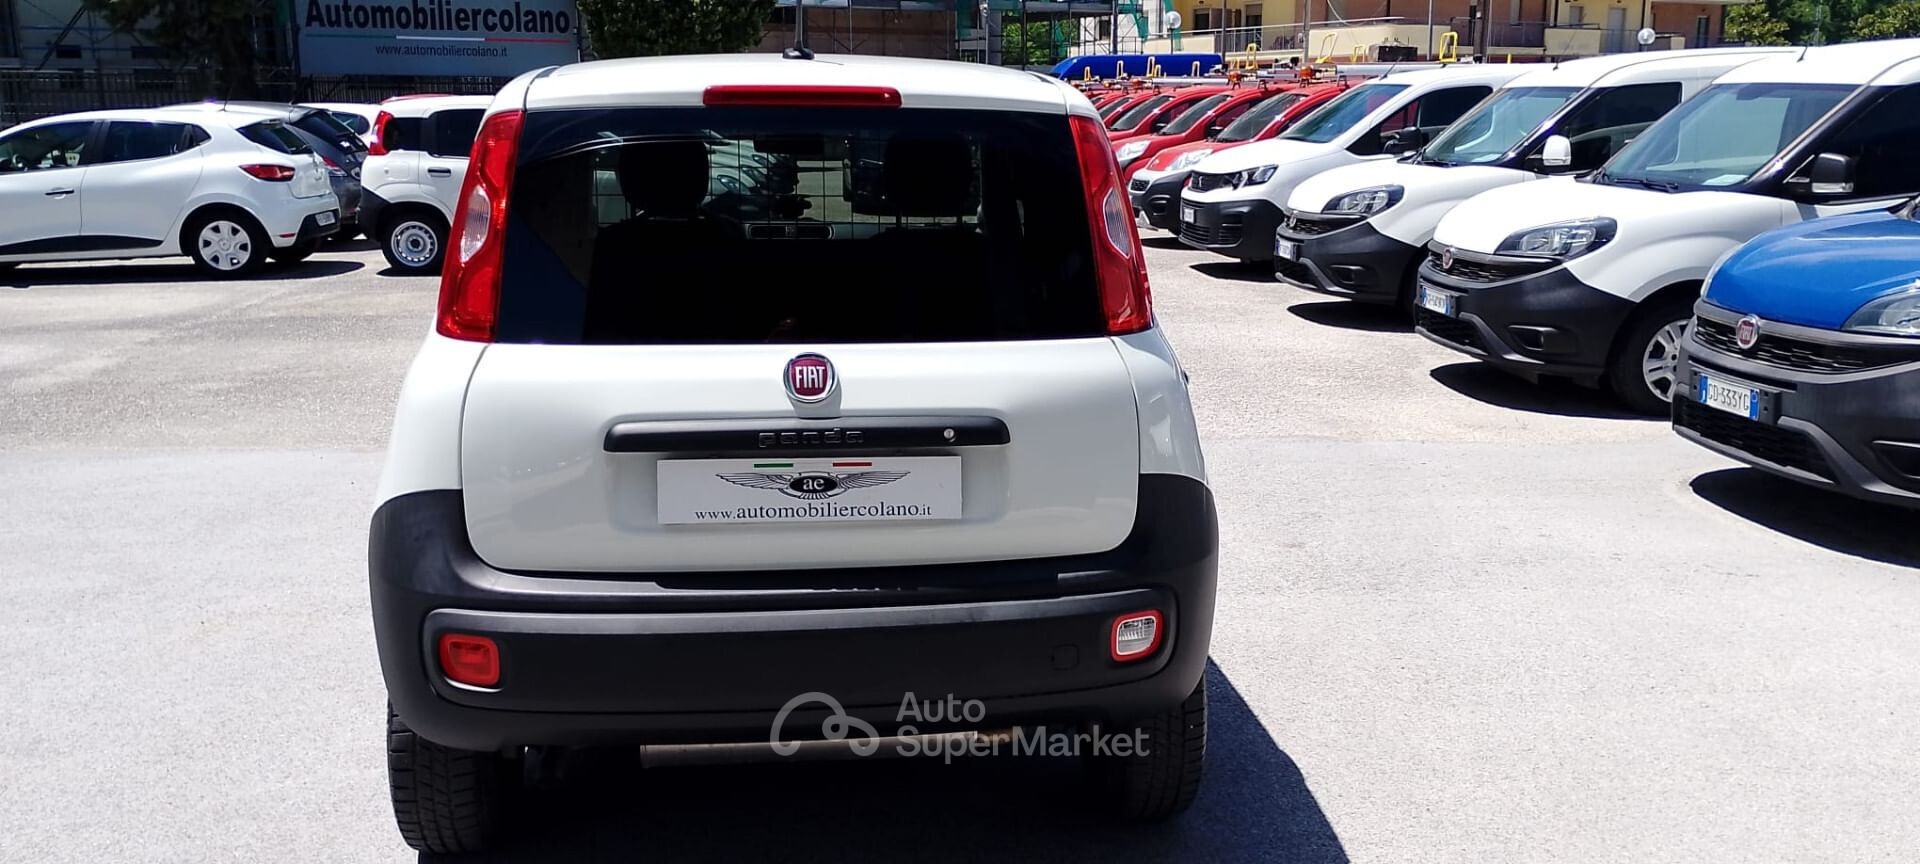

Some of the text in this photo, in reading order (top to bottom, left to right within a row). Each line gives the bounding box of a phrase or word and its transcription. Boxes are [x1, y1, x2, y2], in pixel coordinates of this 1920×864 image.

[305, 0, 570, 33] Automobiliercolano
[375, 44, 508, 57] www.automobiliercolano.it
[795, 365, 826, 389] FIAT
[758, 427, 865, 447] panda
[802, 476, 825, 490] ae
[694, 502, 932, 520] www.automobiliercolano.it
